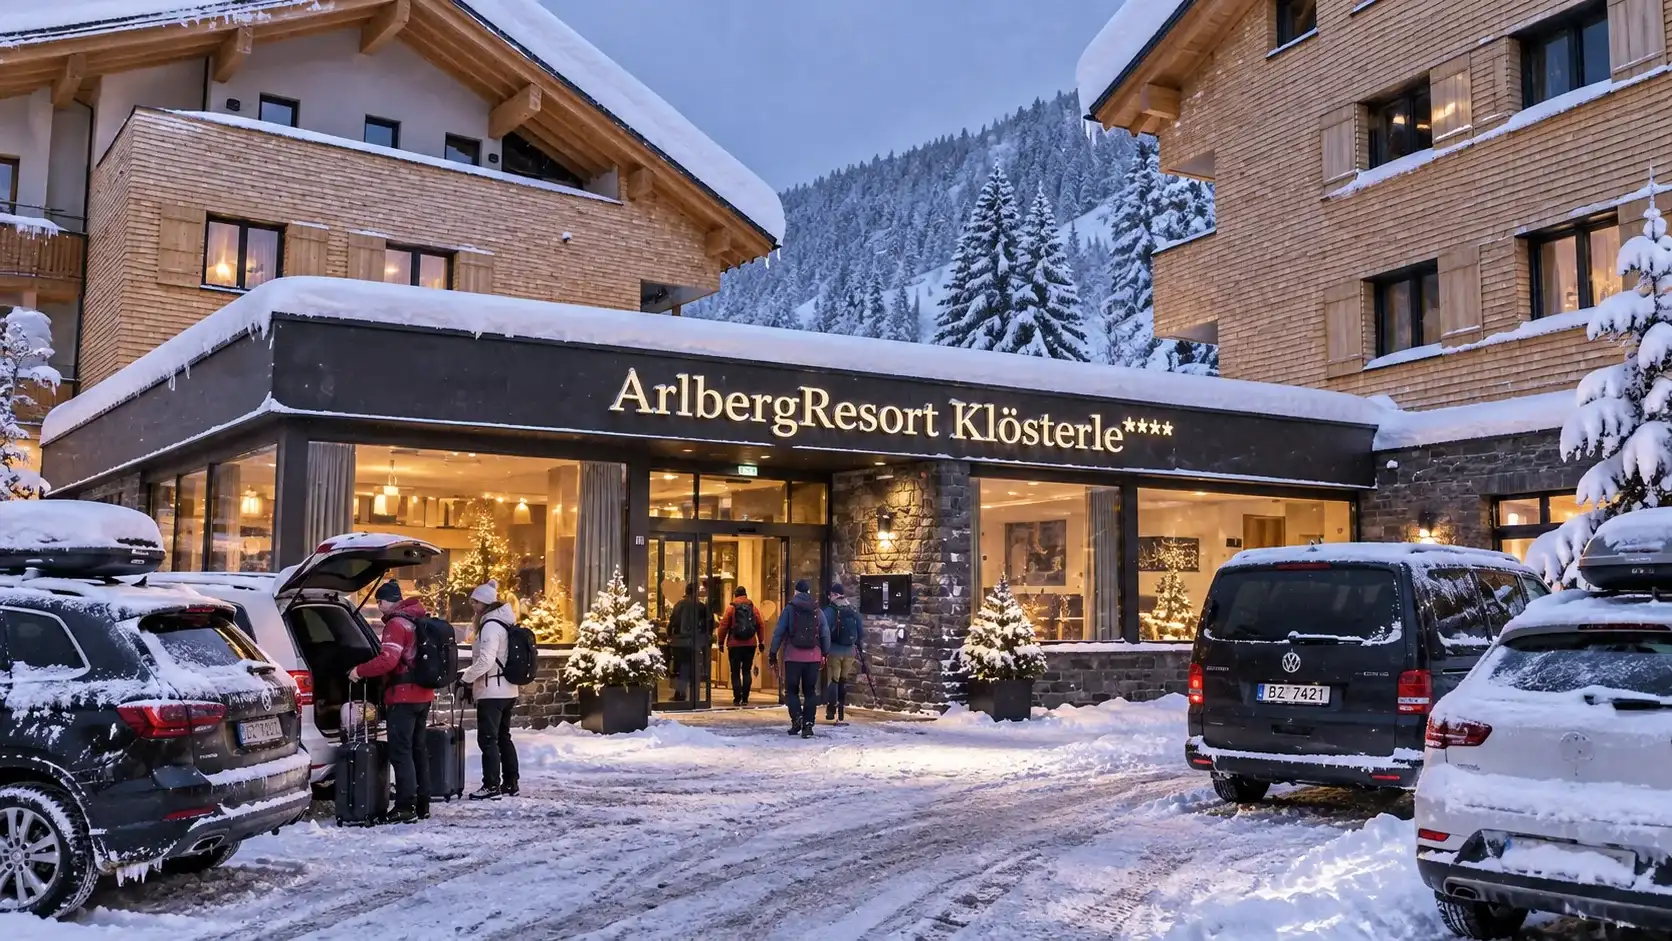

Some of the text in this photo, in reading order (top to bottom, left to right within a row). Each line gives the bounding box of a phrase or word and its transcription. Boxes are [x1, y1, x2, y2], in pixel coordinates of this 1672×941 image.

[608, 367, 1124, 453] ArlbergResort Klösterle
[1293, 687, 1323, 701] 7421
